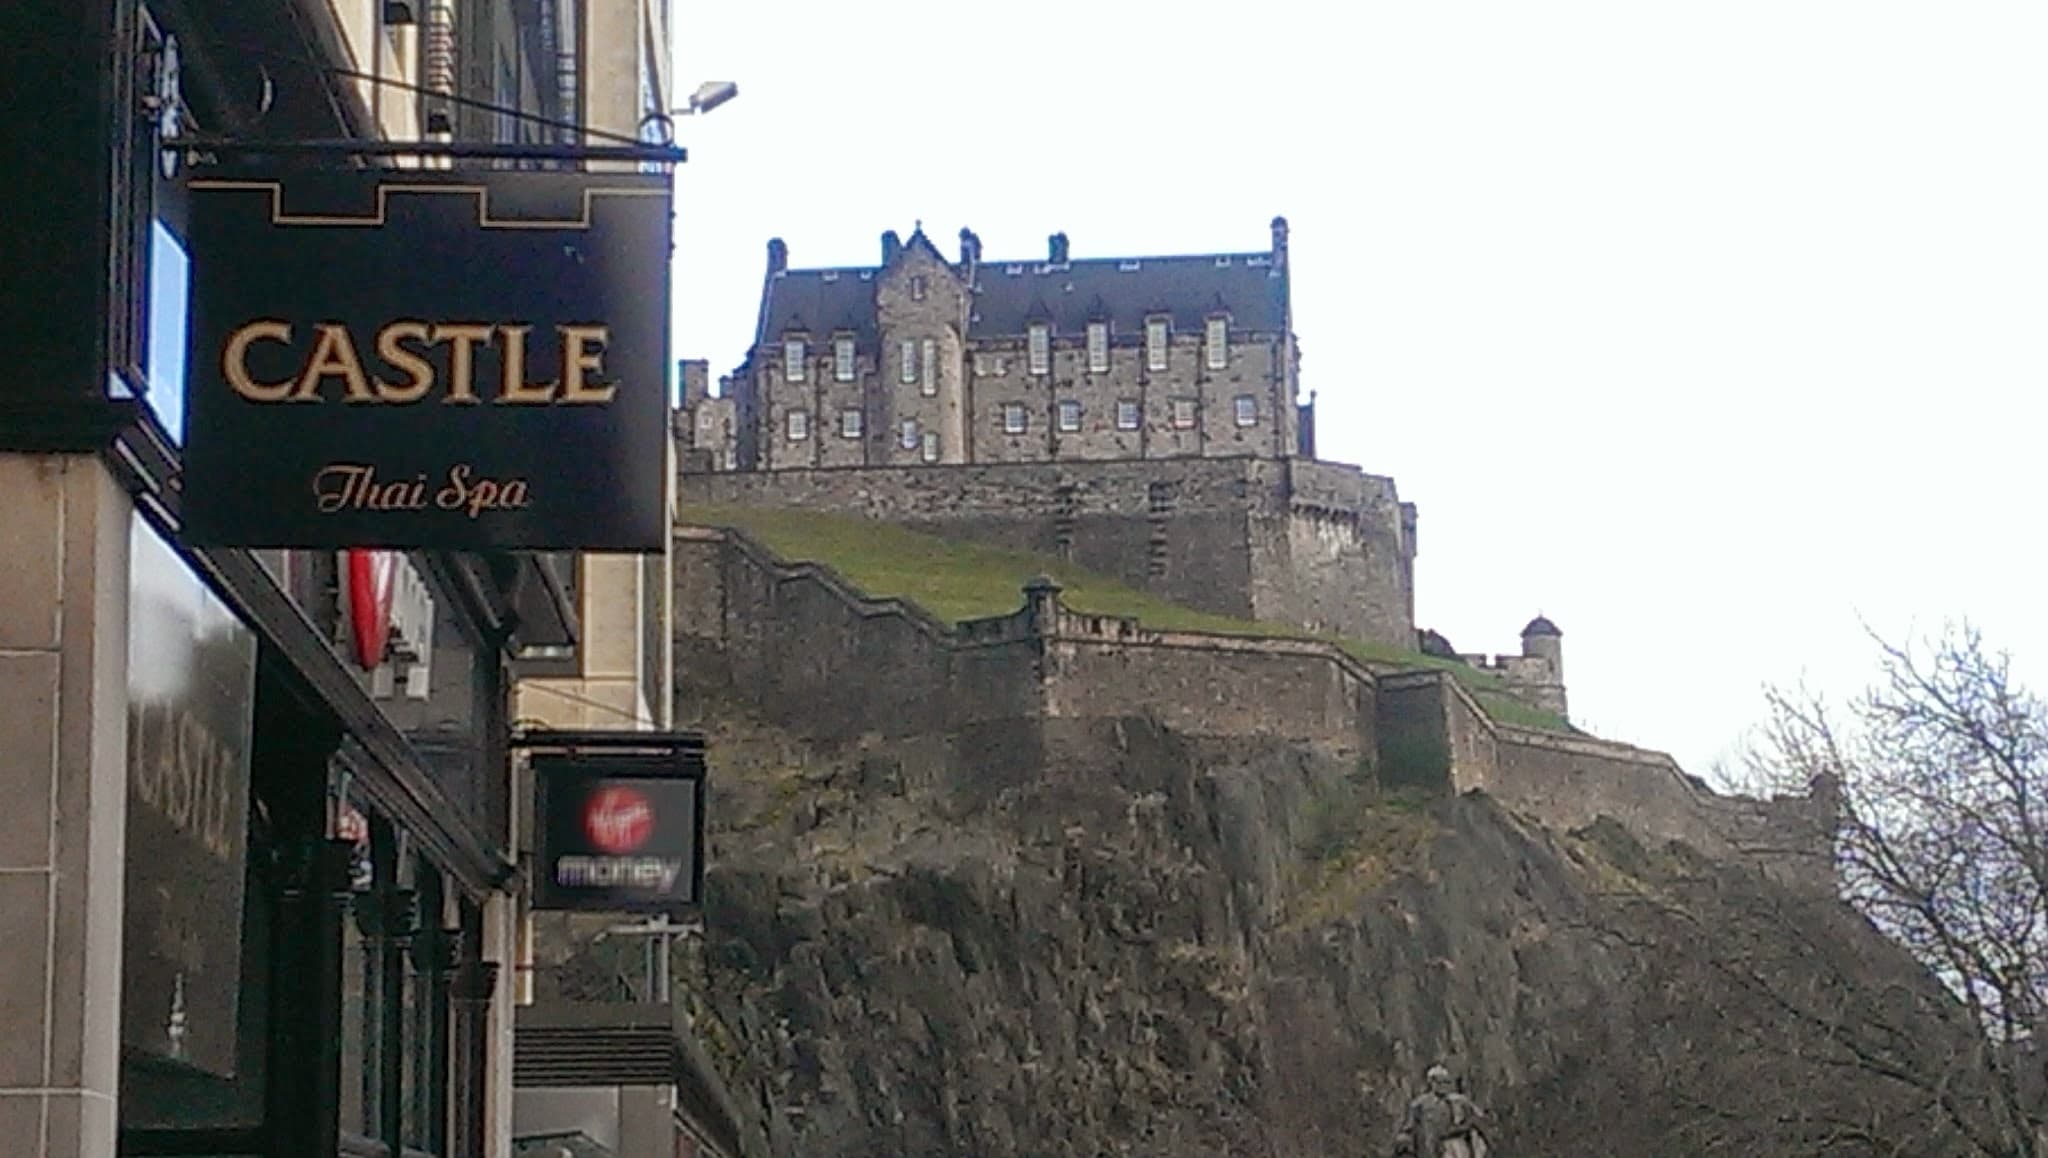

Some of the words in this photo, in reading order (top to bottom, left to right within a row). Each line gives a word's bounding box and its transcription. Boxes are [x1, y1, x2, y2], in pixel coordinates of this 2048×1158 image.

[223, 321, 617, 405] CASTLE
[314, 464, 429, 512] Thai
[436, 465, 530, 517] Spa
[557, 856, 682, 893] money
